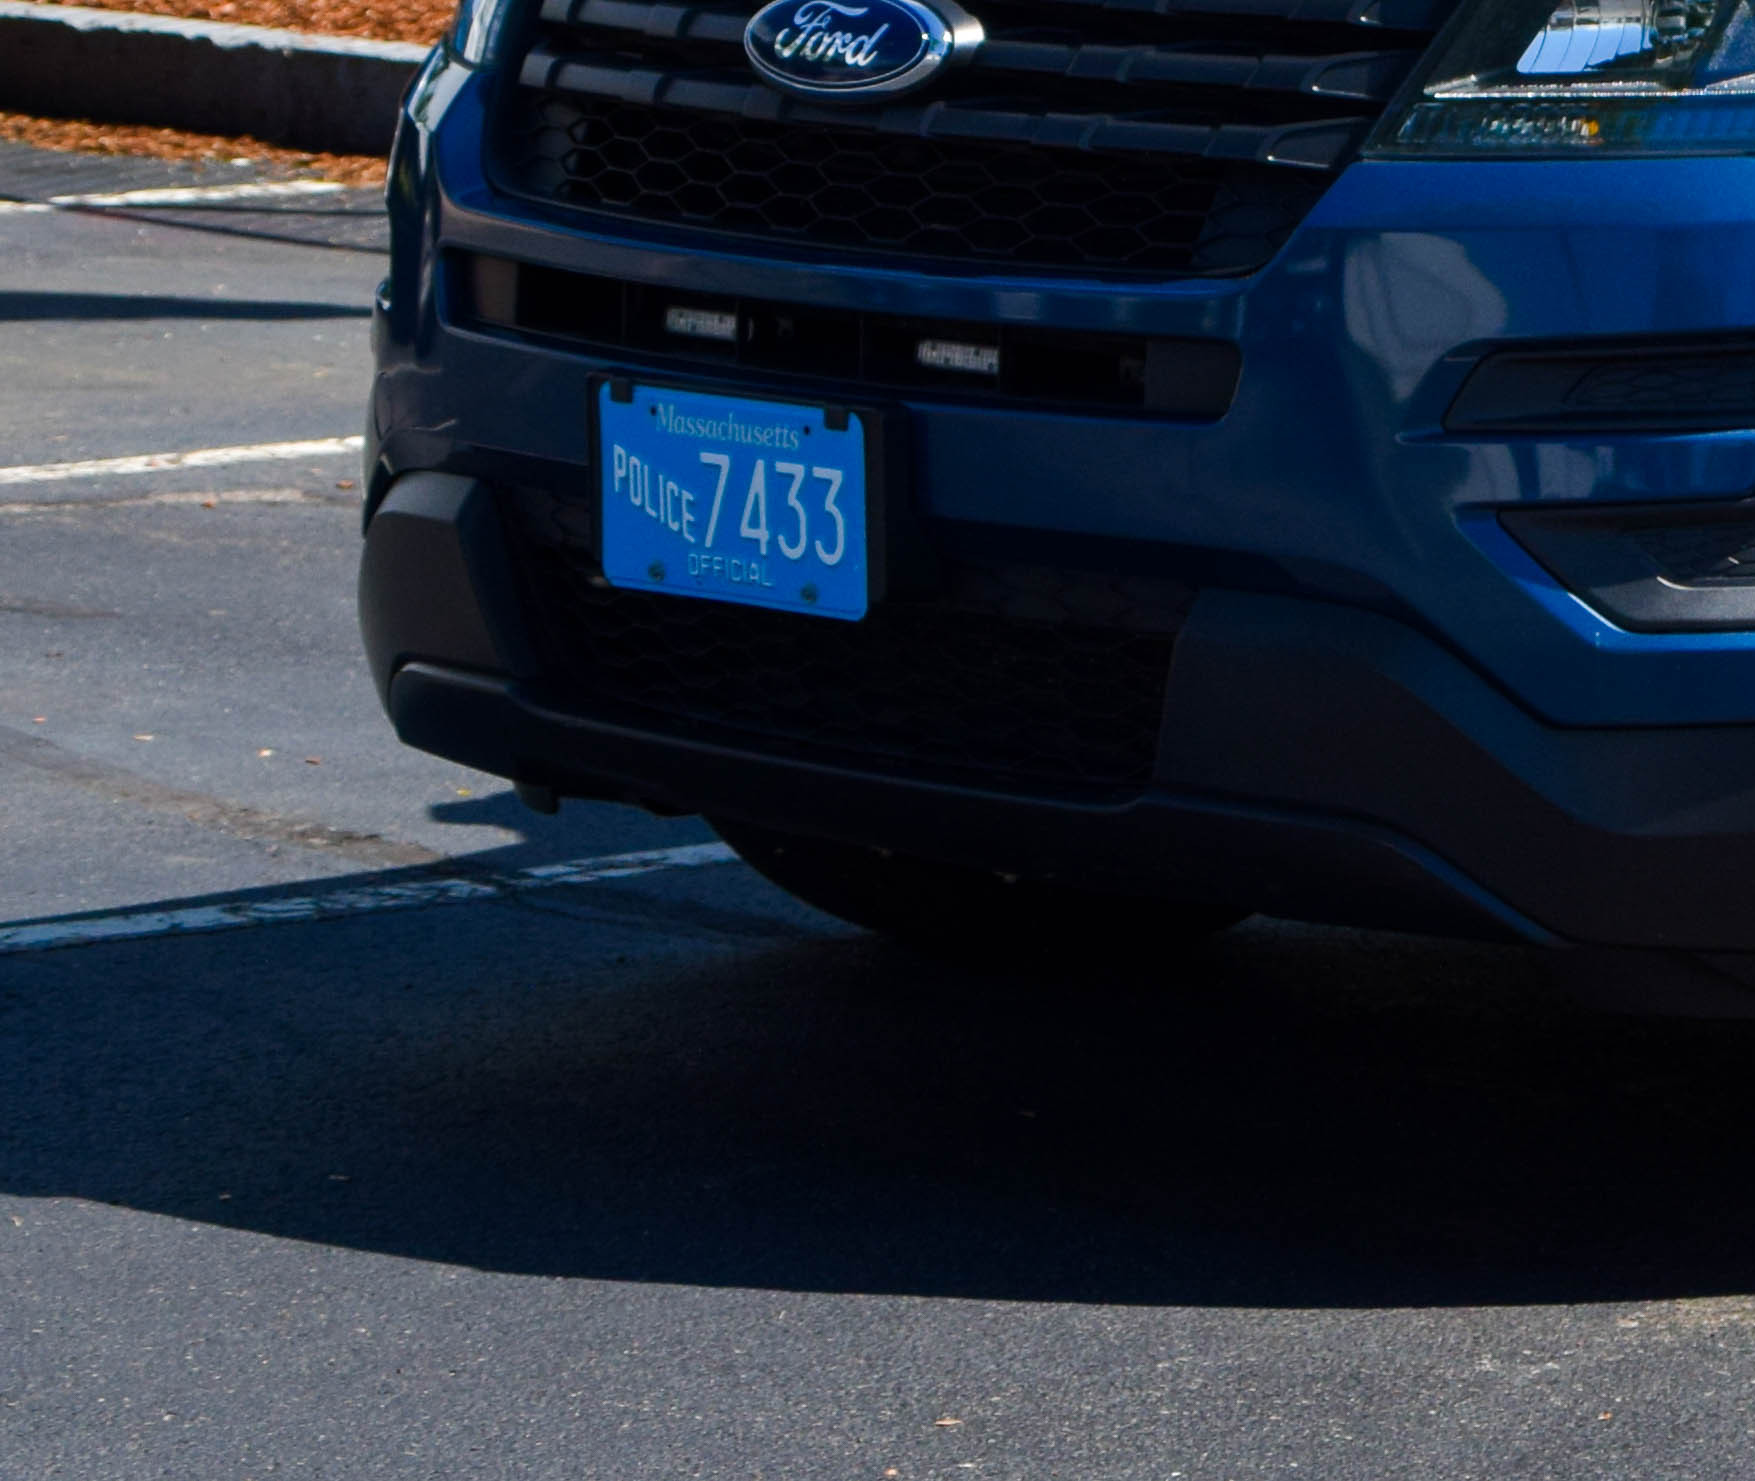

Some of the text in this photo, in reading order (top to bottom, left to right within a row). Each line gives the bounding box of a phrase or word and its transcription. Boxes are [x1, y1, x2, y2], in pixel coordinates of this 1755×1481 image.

[774, 0, 889, 67] Ford
[655, 403, 800, 450] Massachusetts
[612, 444, 846, 566] POLICE 7433
[687, 553, 775, 588] OFFICIAL
